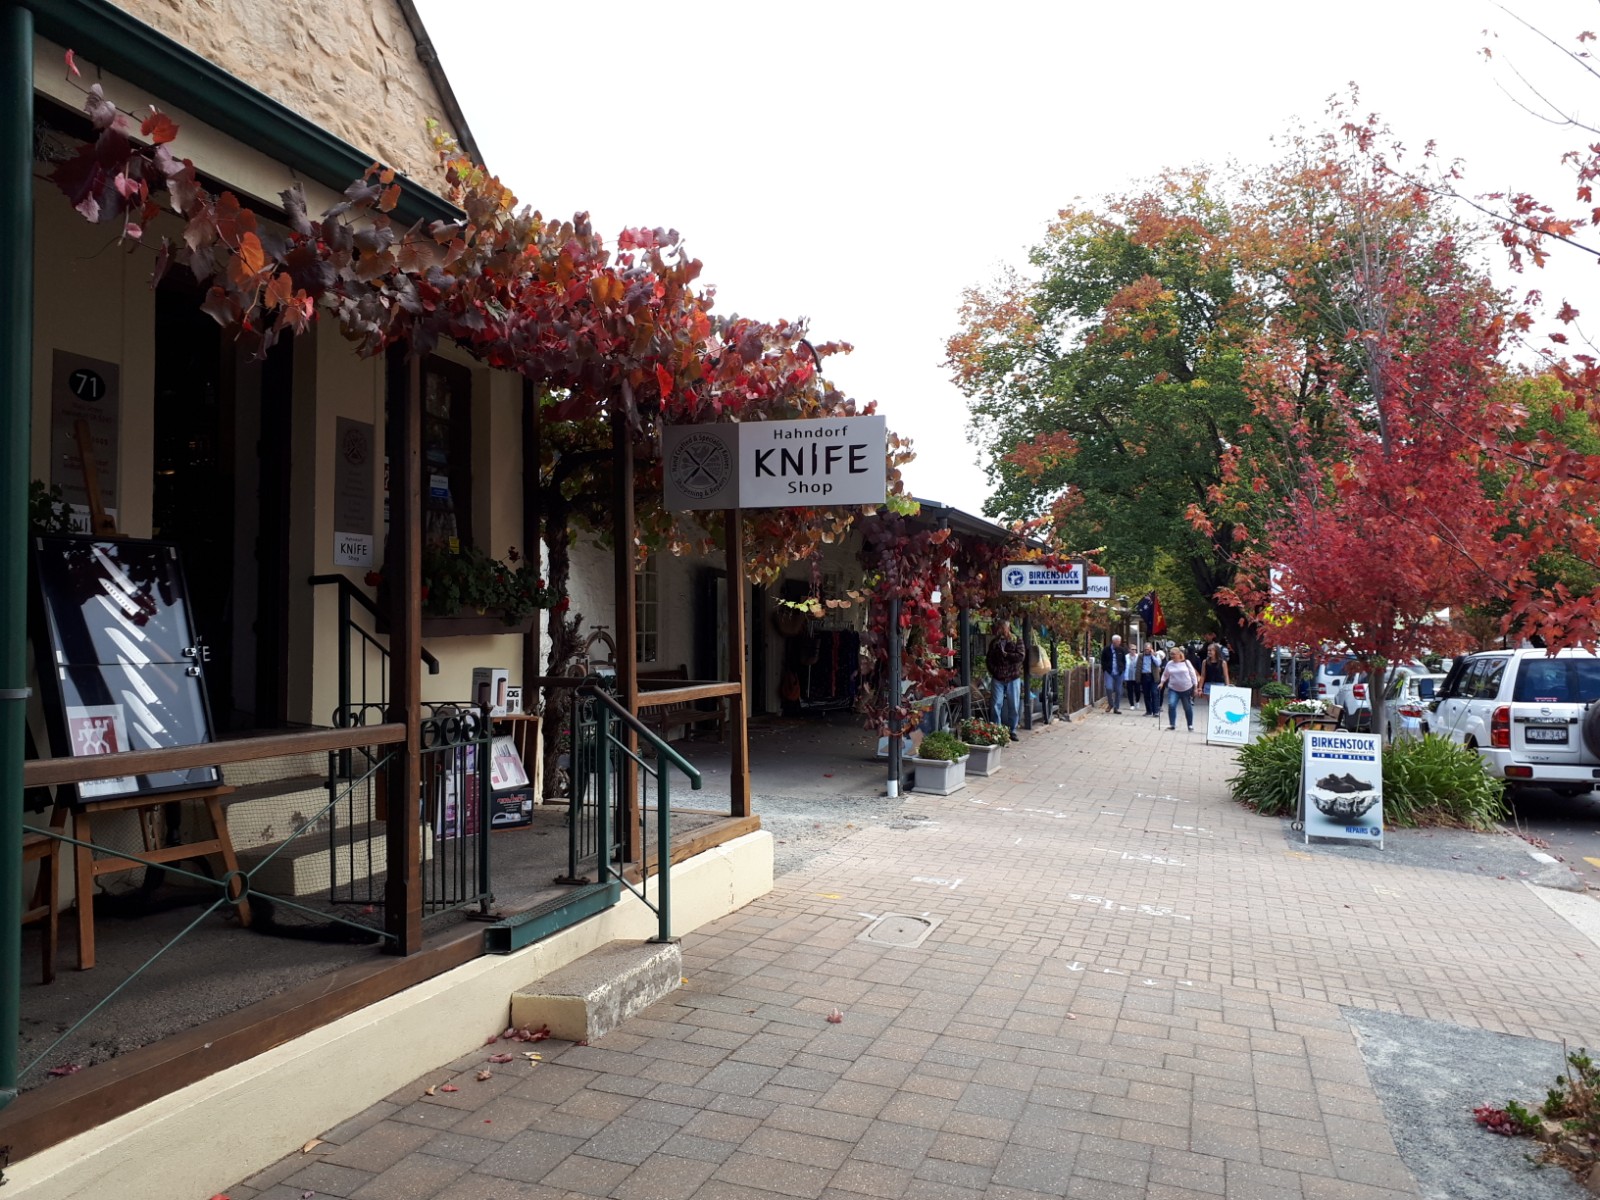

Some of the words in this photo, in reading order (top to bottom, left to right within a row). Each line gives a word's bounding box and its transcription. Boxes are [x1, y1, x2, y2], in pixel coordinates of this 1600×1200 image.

[75, 373, 97, 398] 71
[774, 425, 848, 440] Hahndorf
[755, 442, 869, 477] KNIFE
[788, 481, 833, 495] Shop
[340, 543, 367, 555] KNIFE
[1029, 570, 1079, 579] BIRKENSTOCK
[1312, 736, 1375, 751] BIRKENSTOCK
[1346, 826, 1368, 835] REPAIRS
